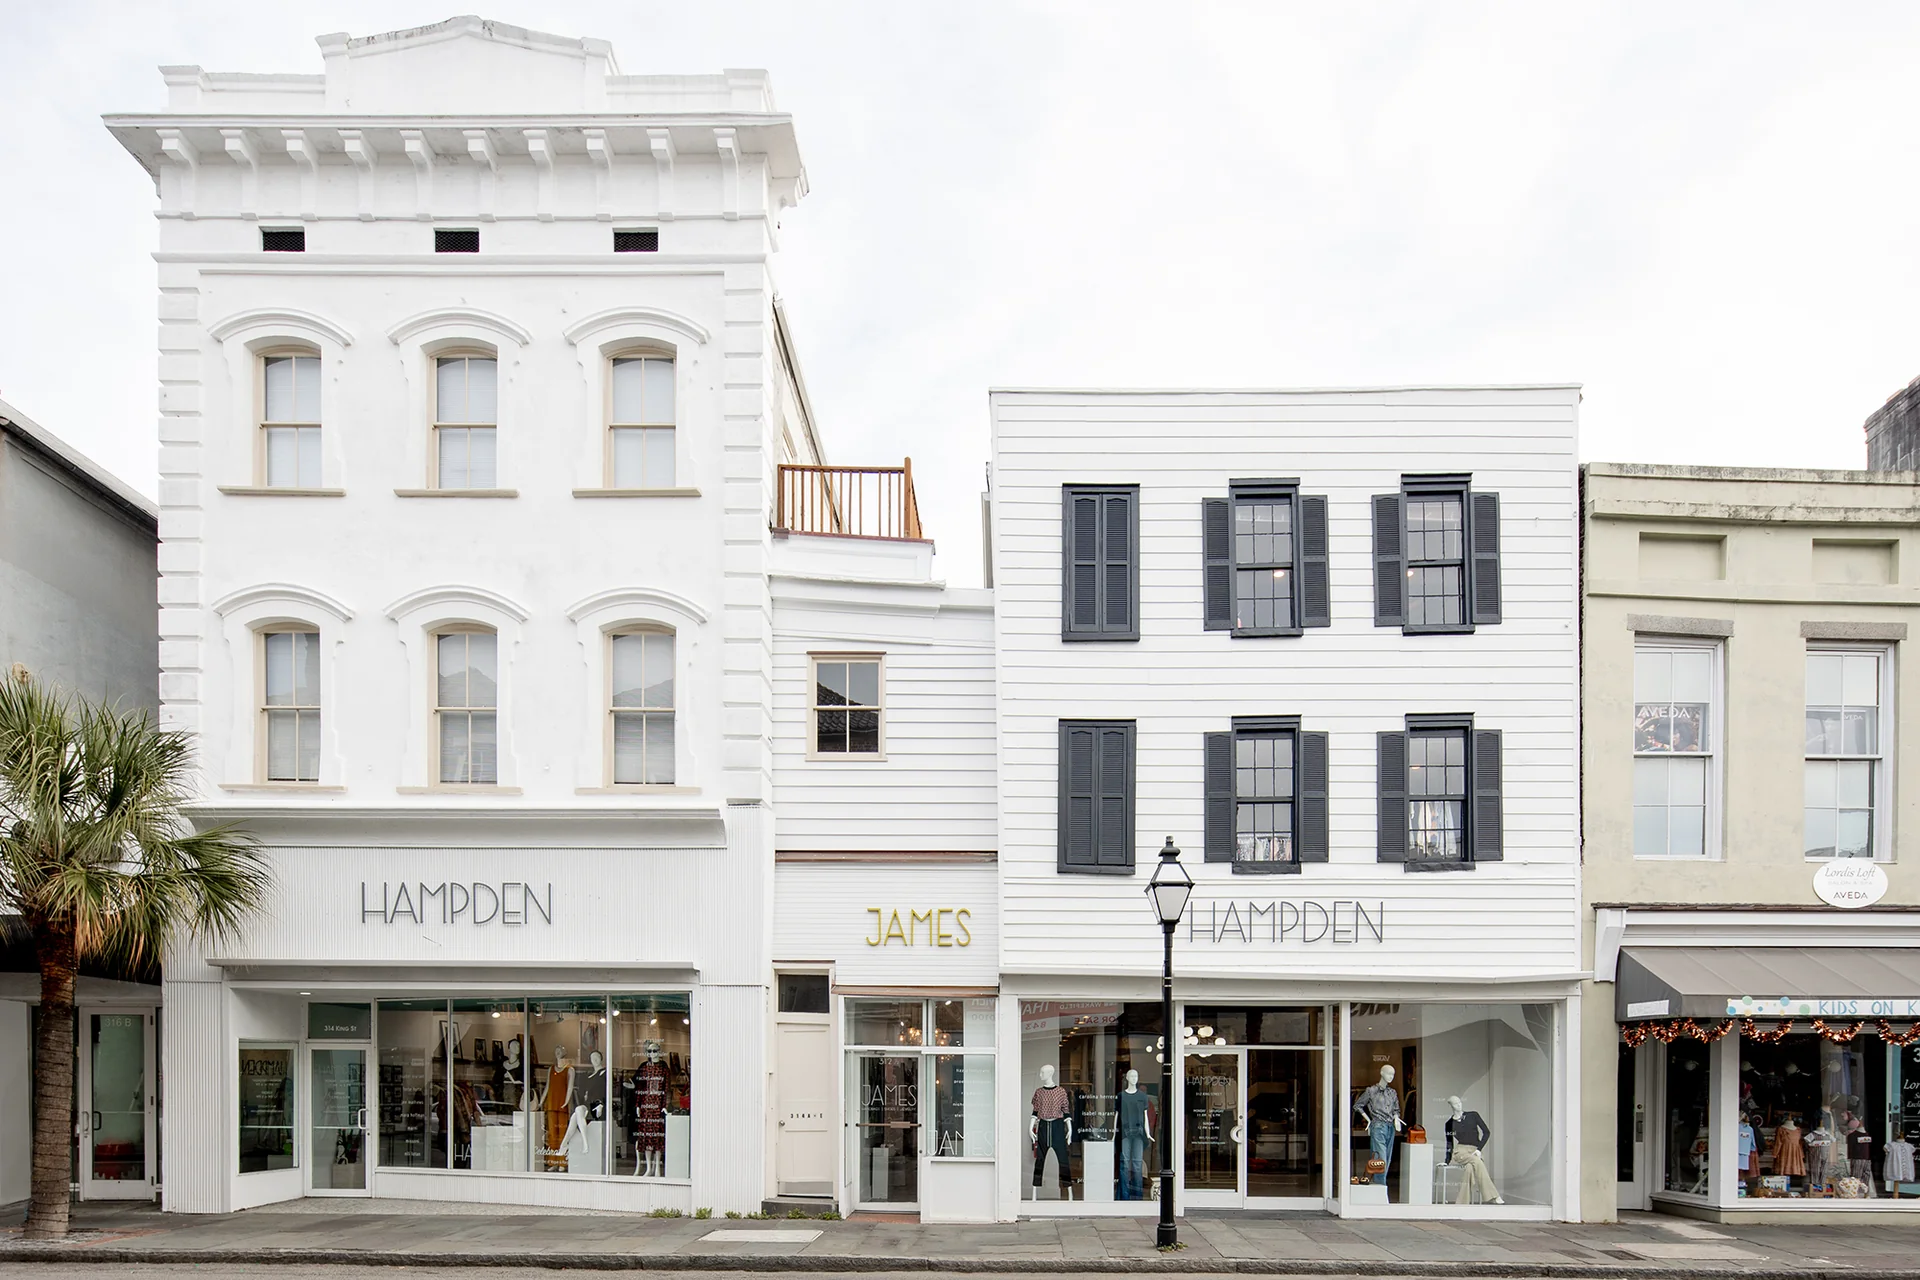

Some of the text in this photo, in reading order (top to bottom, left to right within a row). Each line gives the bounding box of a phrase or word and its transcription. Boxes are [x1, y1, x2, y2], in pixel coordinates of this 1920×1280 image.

[1638, 706, 1690, 718] AVEDA
[1824, 865, 1876, 880] Lordis Loft
[1833, 891, 1868, 900] AVEDA
[361, 881, 552, 925] HAMPDEN
[866, 907, 972, 947] JAMES
[1190, 901, 1384, 944] HAMPDEN
[1819, 1001, 1917, 1015] KIDS ON K
[104, 1017, 132, 1027] 316 B
[1187, 1076, 1231, 1086] HAMPDEN
[861, 1085, 917, 1107] JAMES
